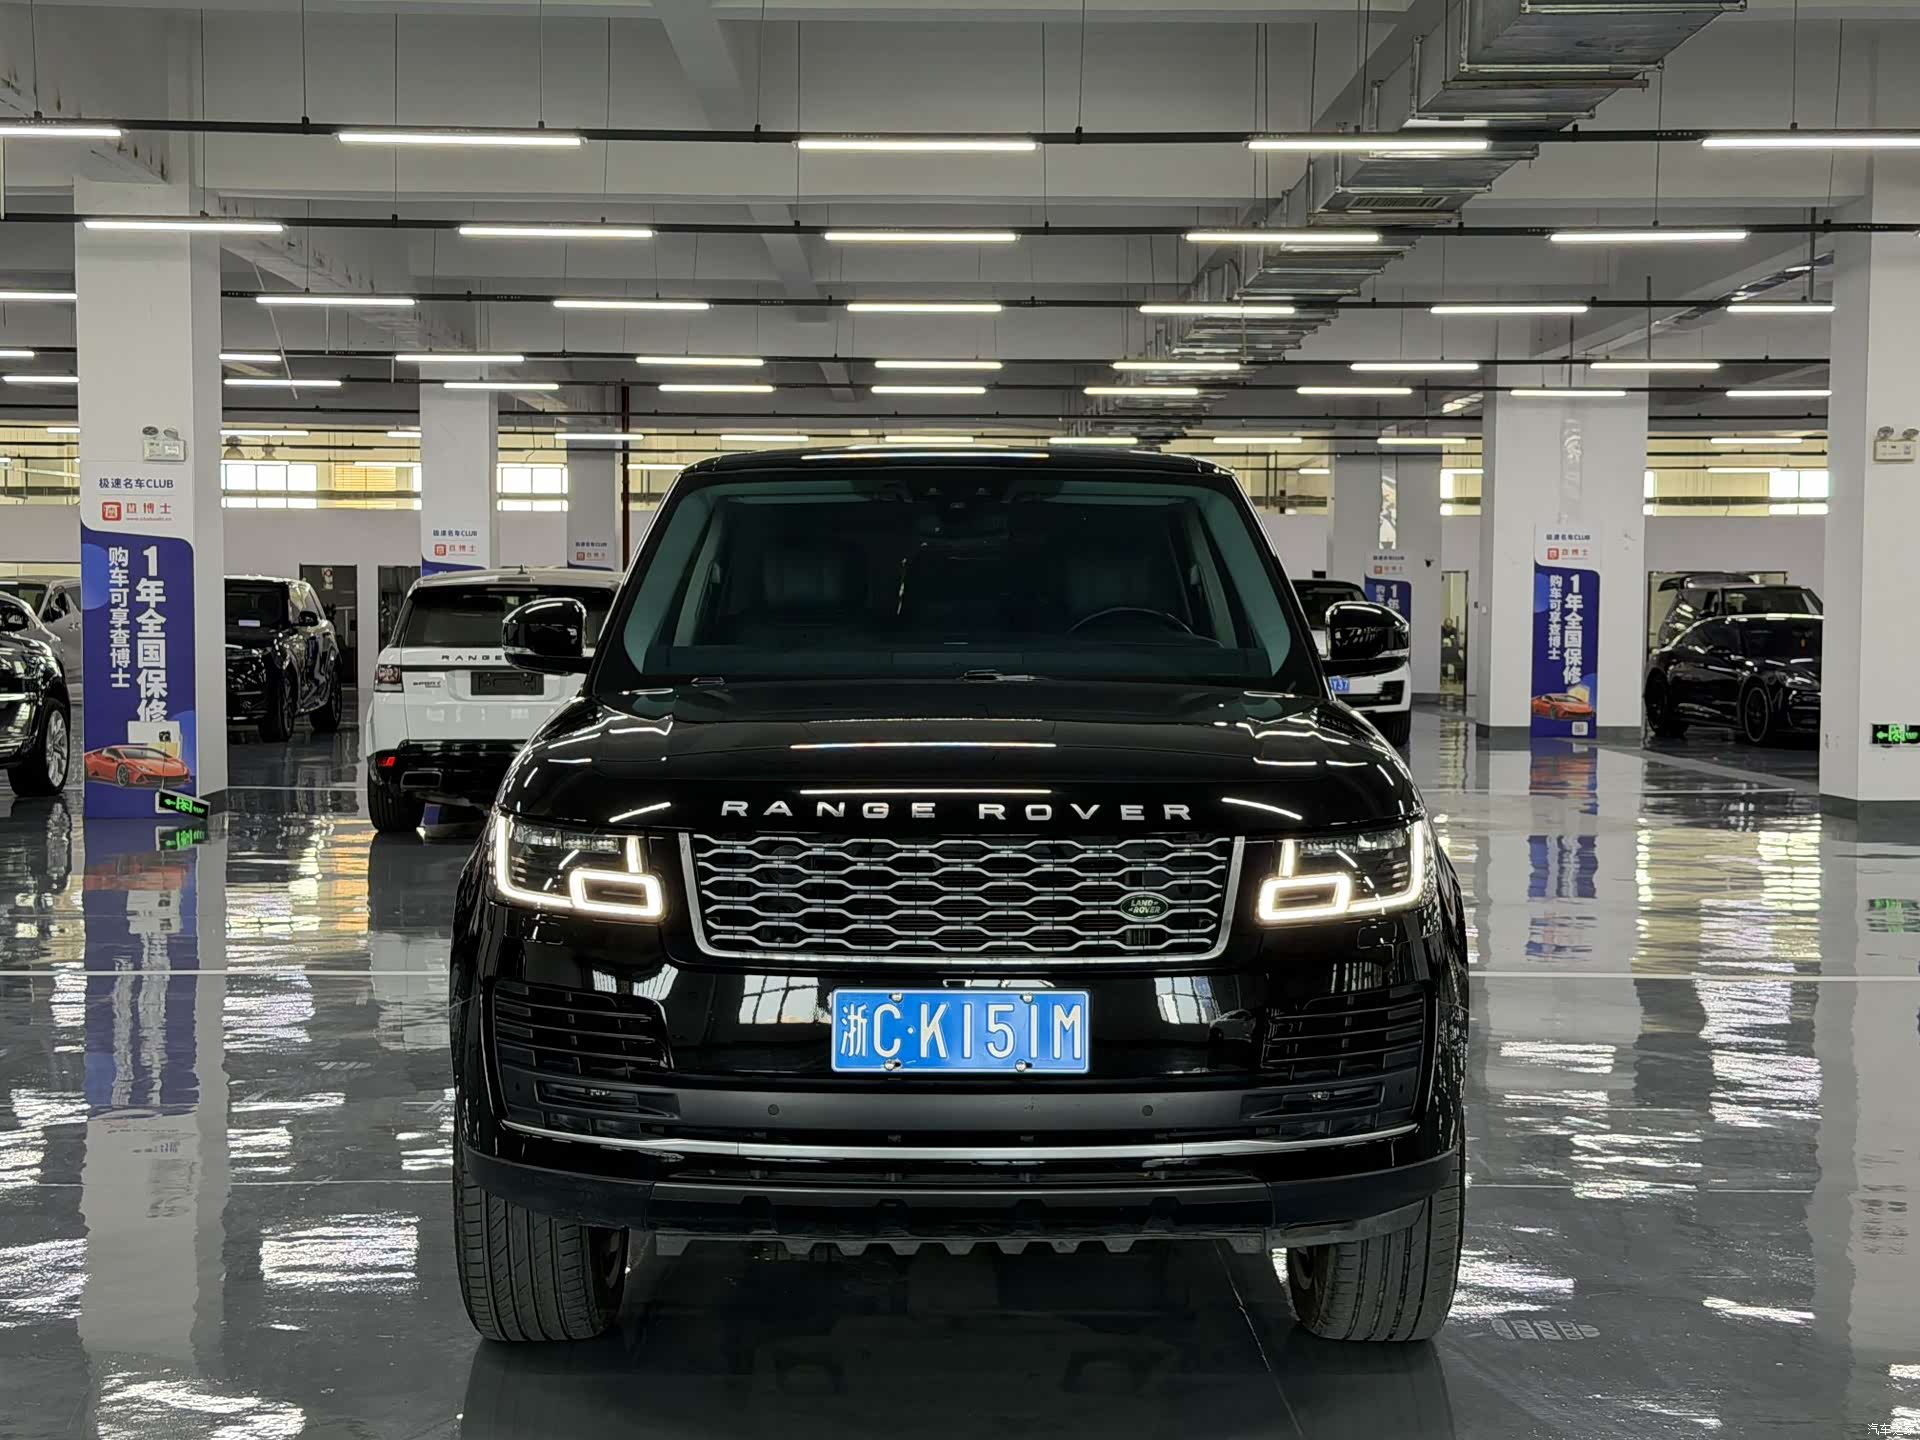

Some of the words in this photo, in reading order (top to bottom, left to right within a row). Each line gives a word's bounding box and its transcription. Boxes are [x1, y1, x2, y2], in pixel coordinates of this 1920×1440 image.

[99, 478, 174, 489] 极速名车CLUB
[108, 547, 131, 688] 购车可享查博士
[136, 546, 168, 722] 1年全国保修
[1563, 573, 1583, 685] 1年全国保修
[720, 801, 937, 819] RANGE
[978, 803, 1193, 821] ROVER
